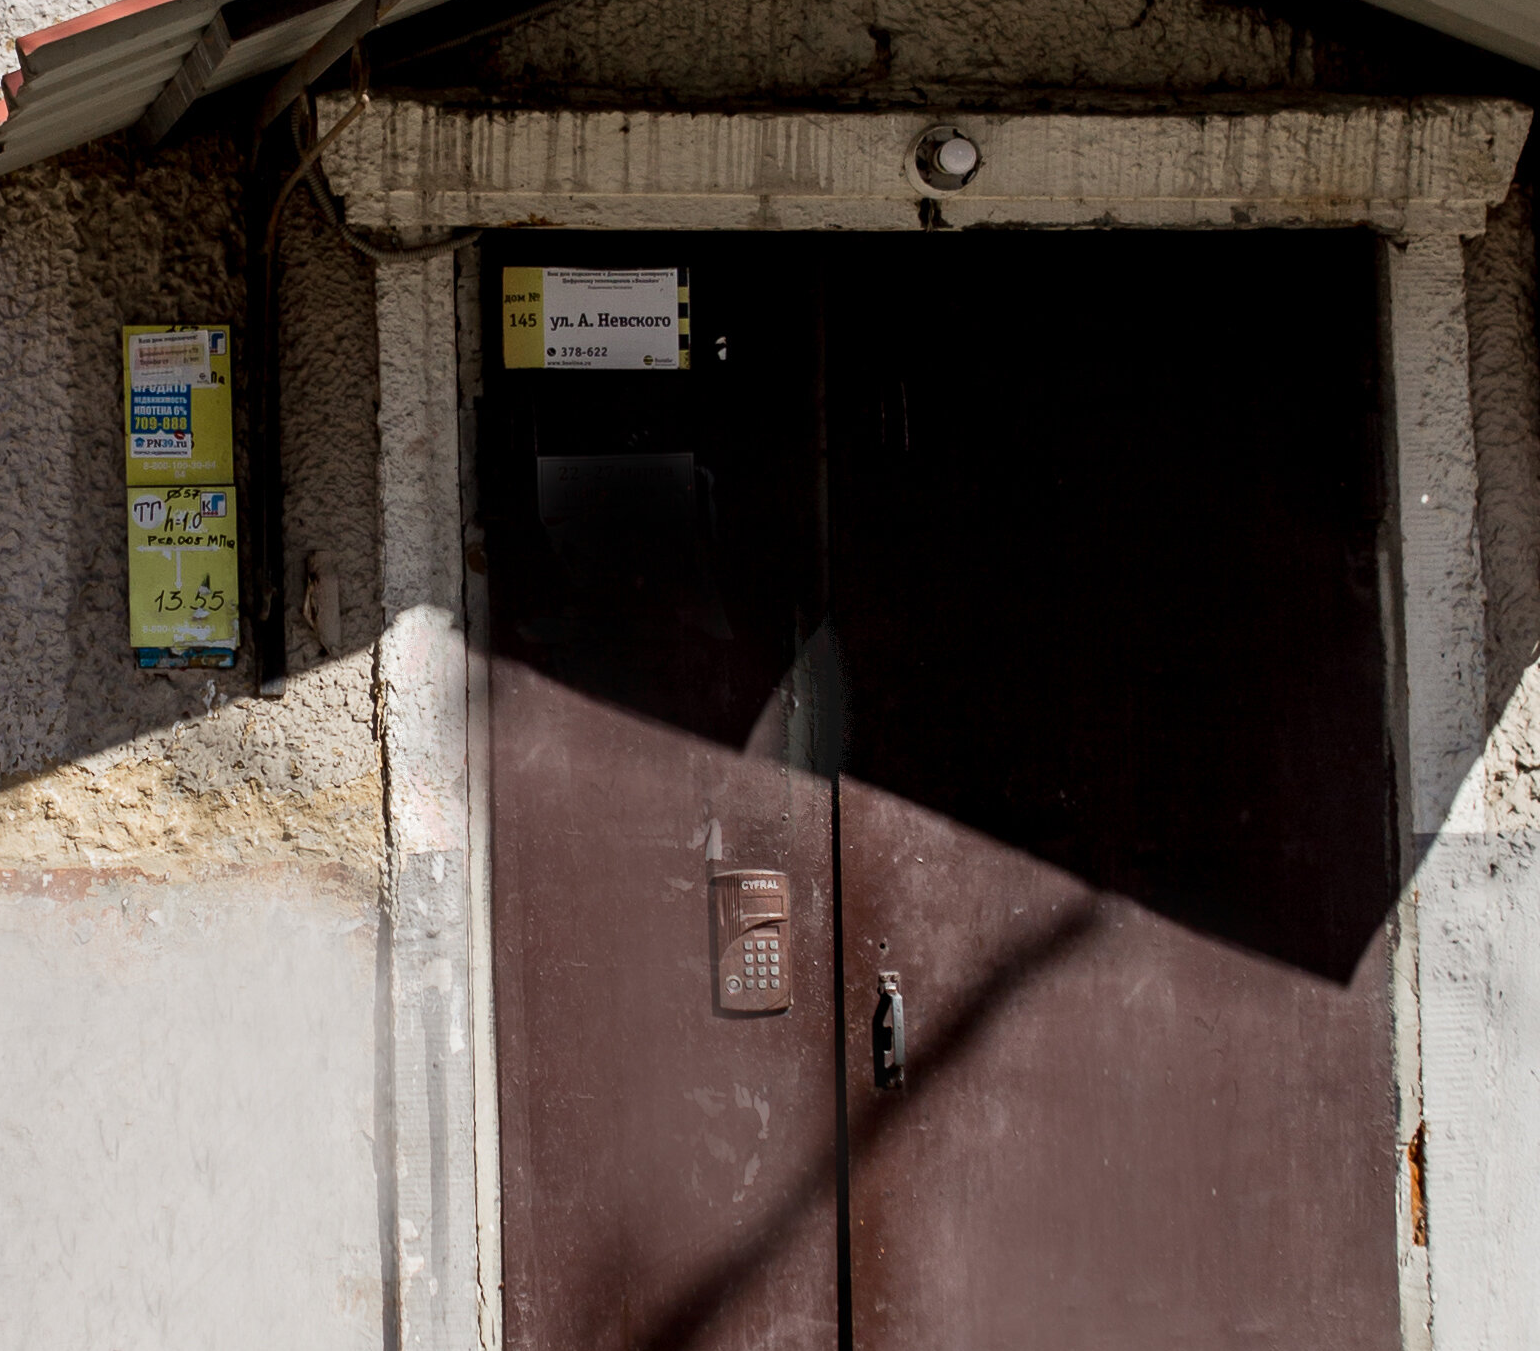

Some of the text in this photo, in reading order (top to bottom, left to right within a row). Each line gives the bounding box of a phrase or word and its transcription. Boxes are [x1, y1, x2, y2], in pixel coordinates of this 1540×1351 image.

[504, 293, 526, 303] дом
[509, 313, 537, 328] 145
[549, 313, 671, 331] ул. А. Невского
[560, 347, 608, 358] 378-622
[134, 416, 188, 431] 709-888
[146, 438, 188, 449] PN39.ru
[741, 879, 779, 890] CYFRAL
